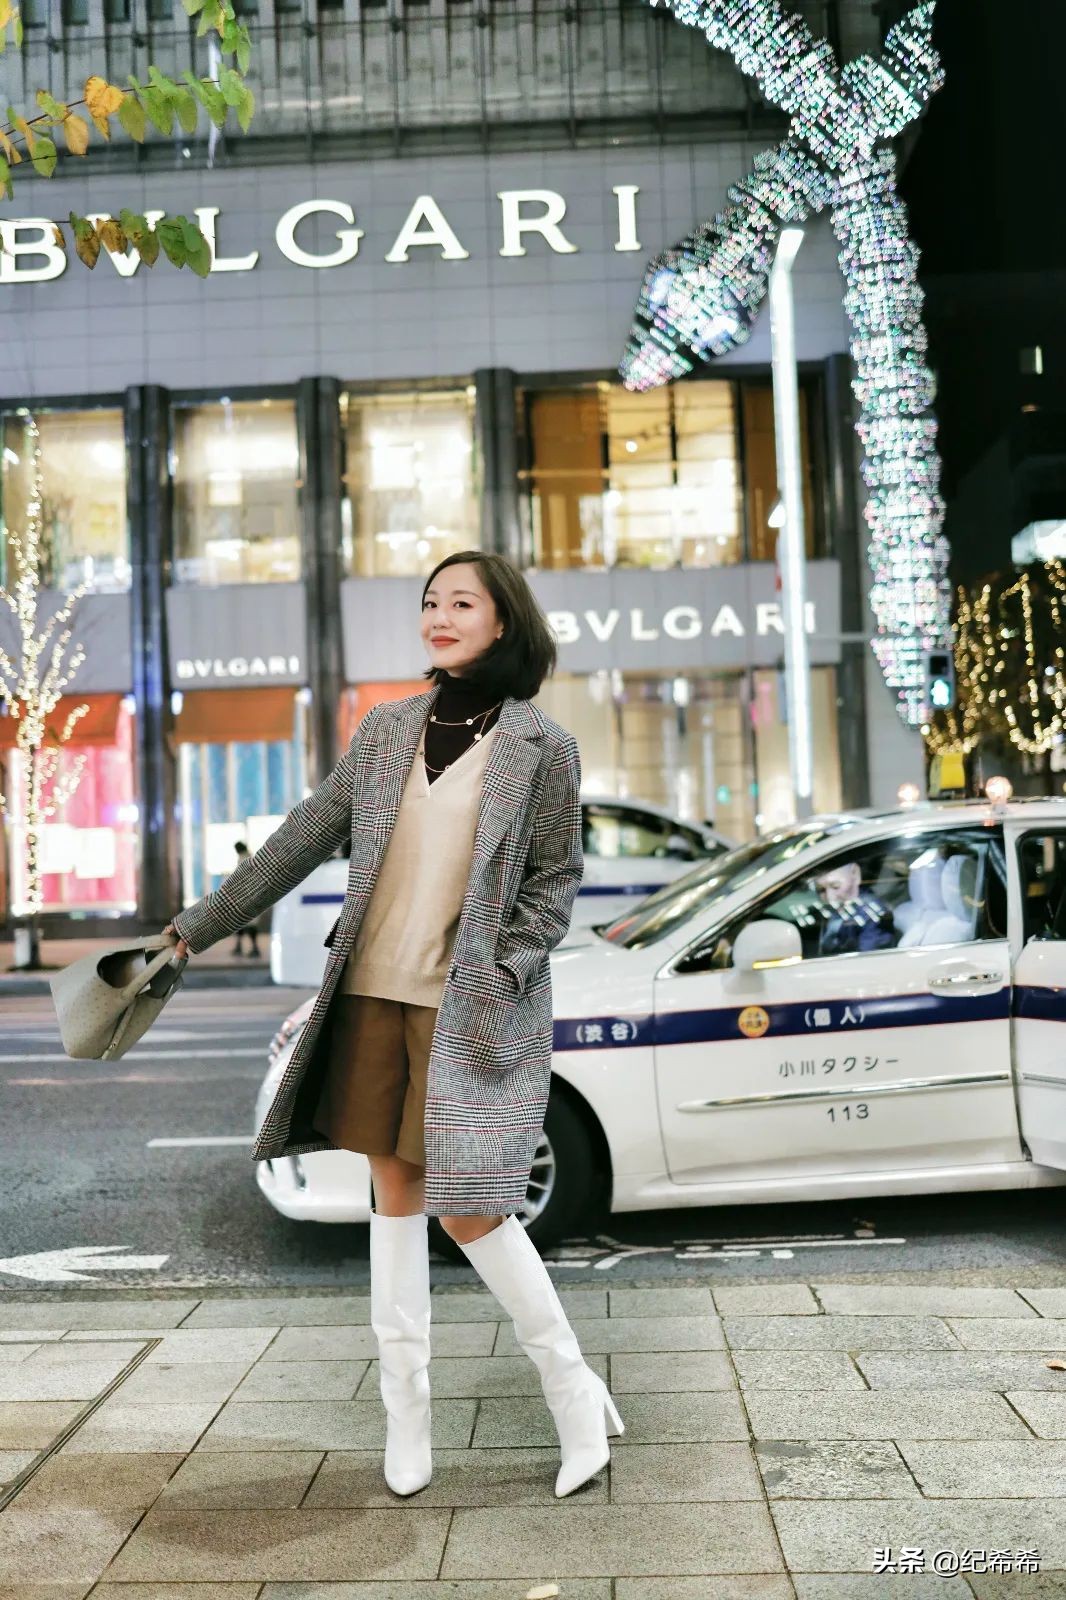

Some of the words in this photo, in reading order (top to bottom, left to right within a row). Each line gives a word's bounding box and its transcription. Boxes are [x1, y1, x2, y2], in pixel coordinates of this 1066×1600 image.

[0, 185, 641, 283] BVLGARI
[547, 602, 816, 643] BVLGARI
[176, 655, 300, 678] BVLGARI
[779, 1056, 899, 1078] 小川タクシー
[827, 1103, 870, 1122] 113
